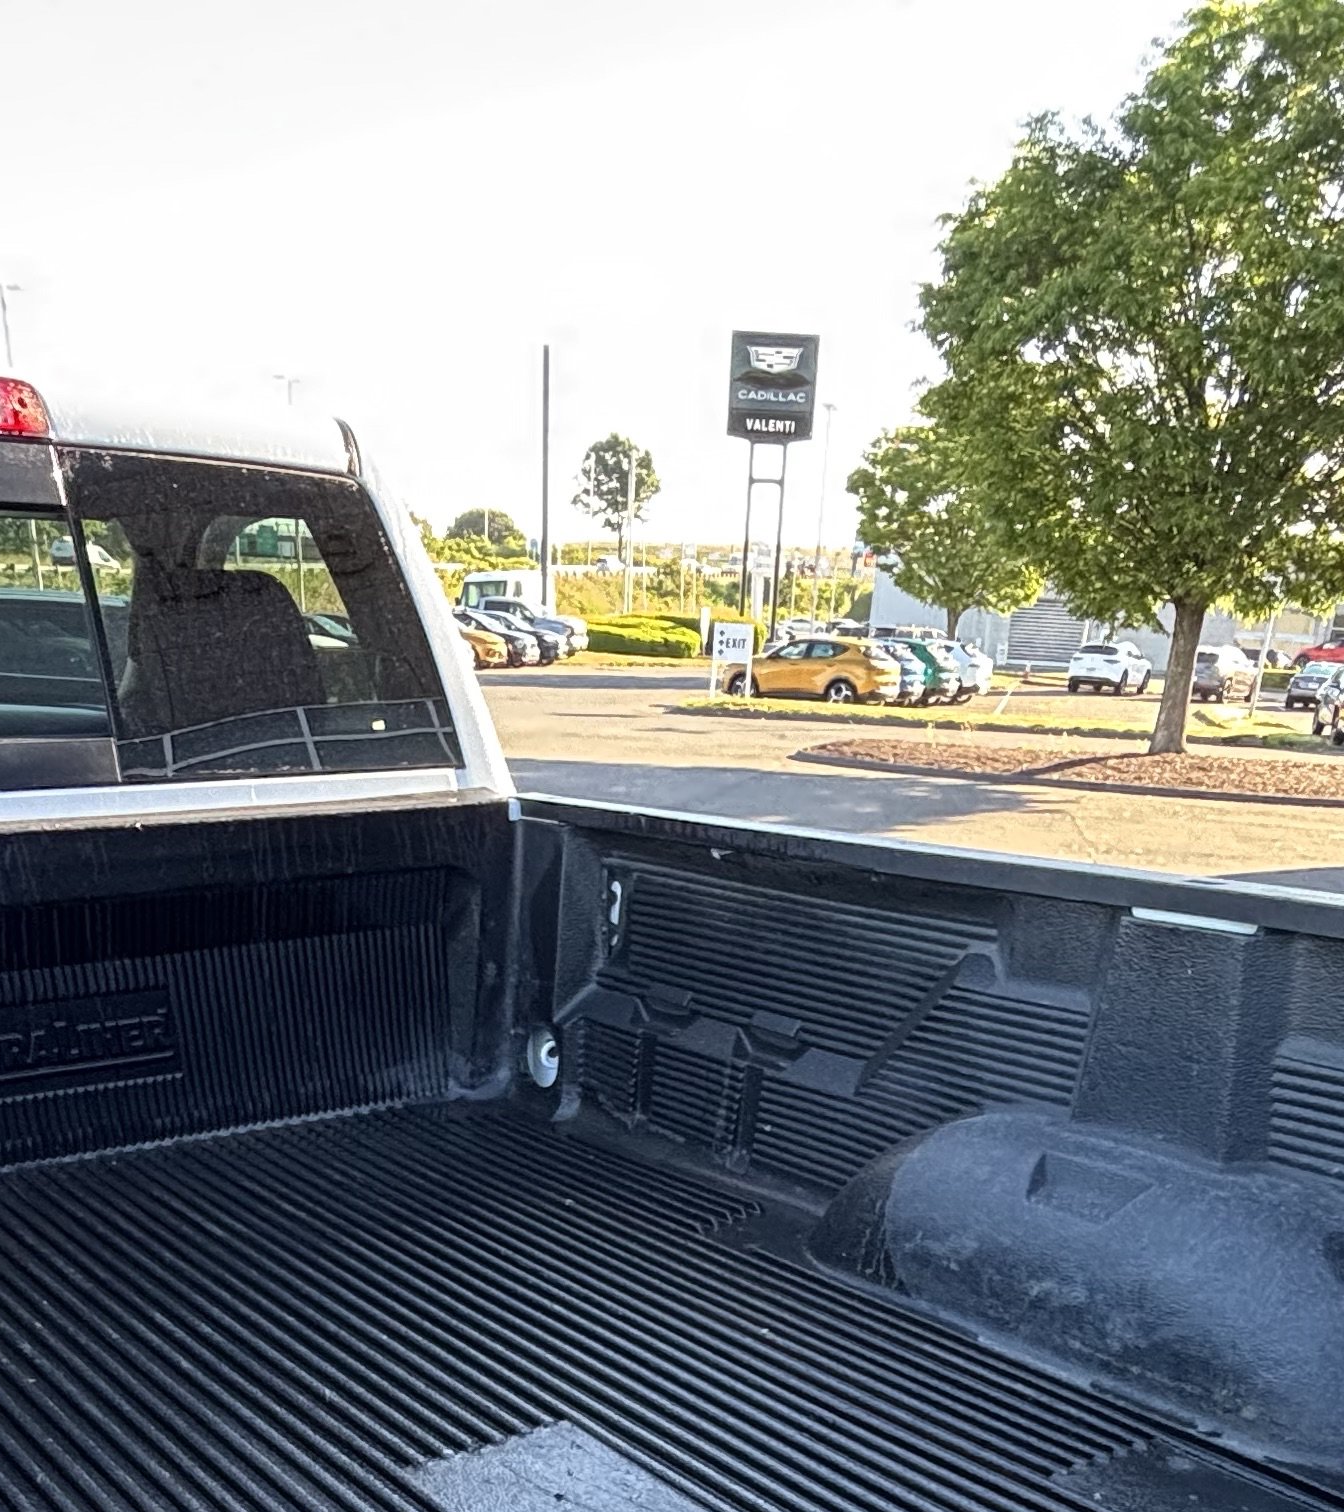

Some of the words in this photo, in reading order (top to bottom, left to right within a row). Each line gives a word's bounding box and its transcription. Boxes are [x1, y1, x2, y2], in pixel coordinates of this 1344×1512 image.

[737, 389, 806, 403] CADILLAC
[745, 418, 796, 434] VALENTI
[725, 637, 747, 650] EXIT
